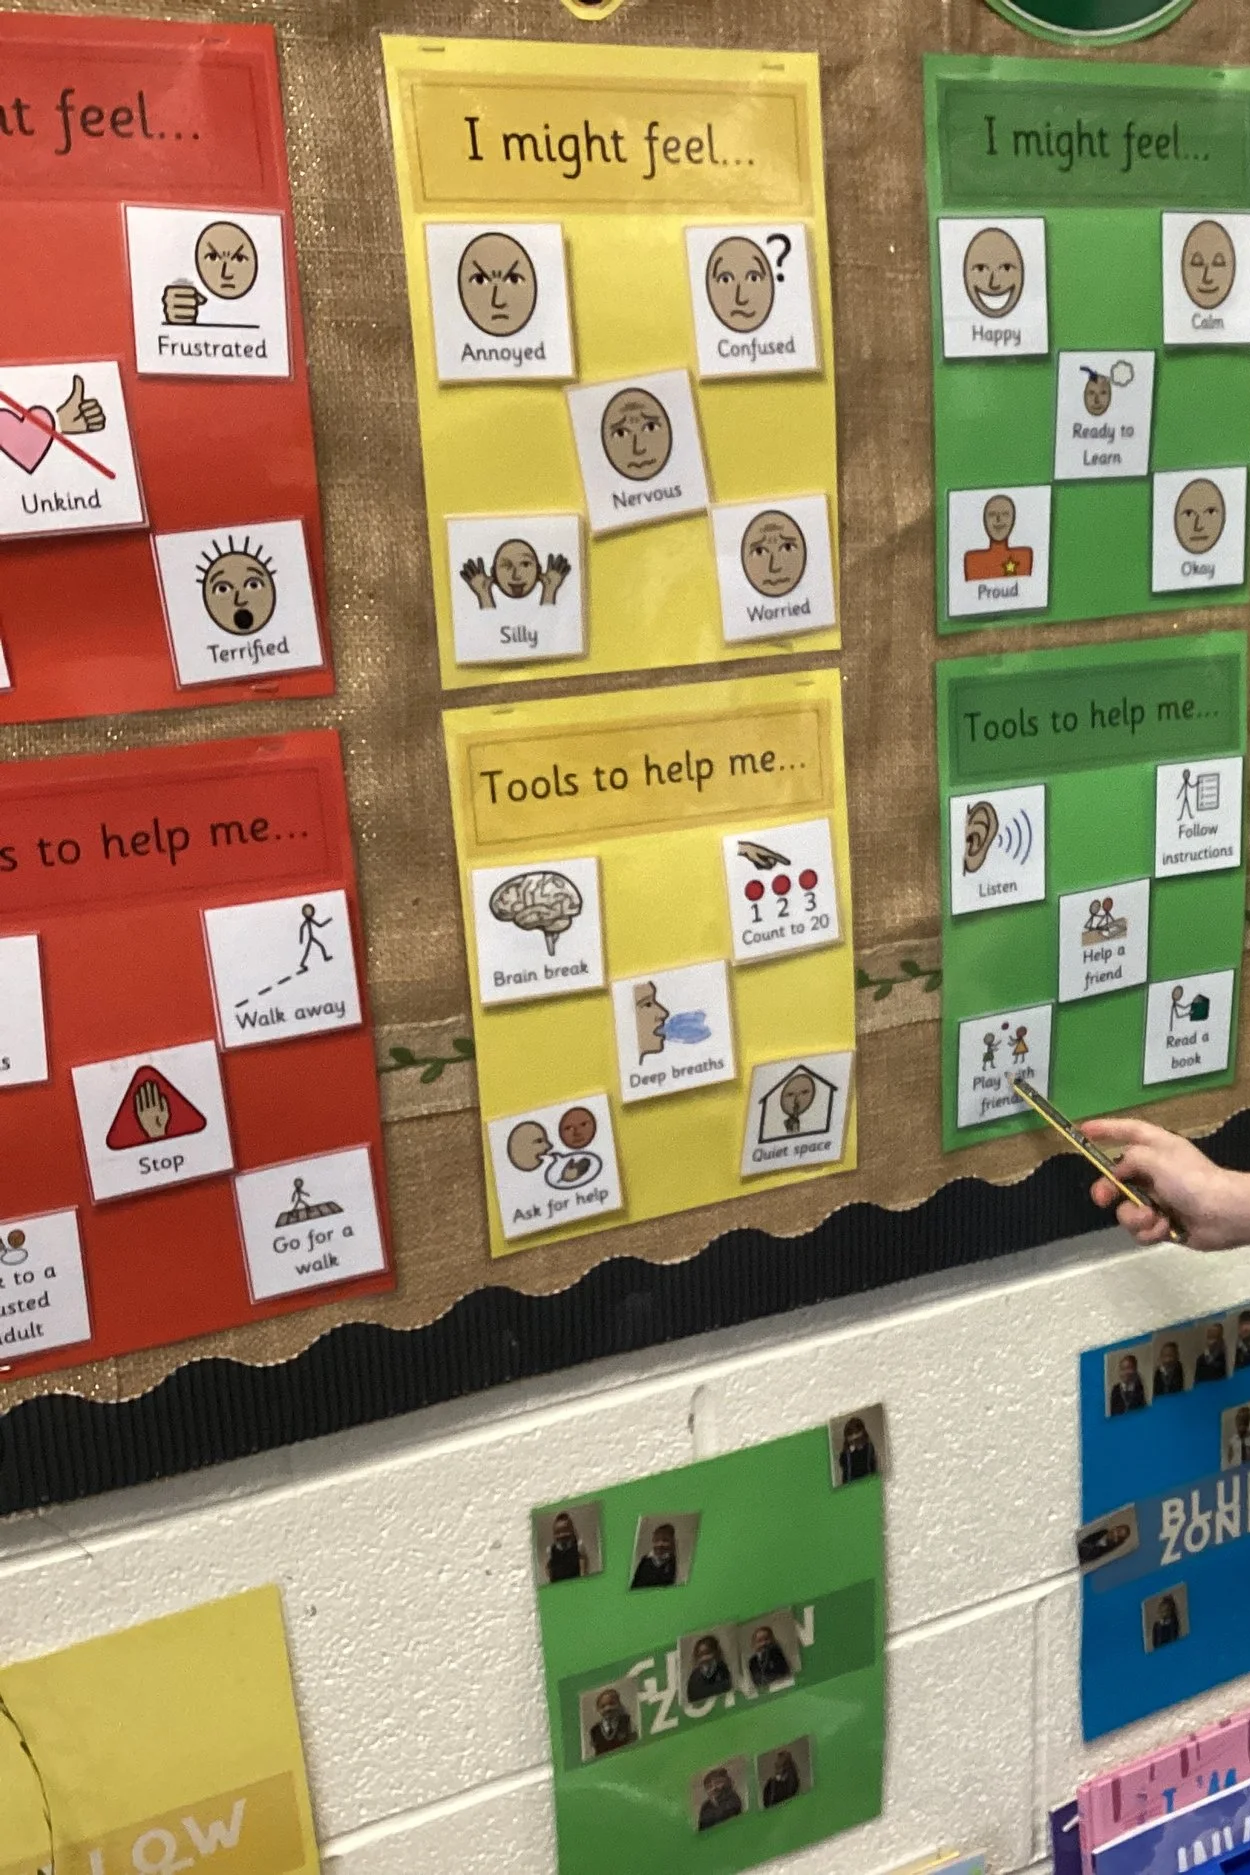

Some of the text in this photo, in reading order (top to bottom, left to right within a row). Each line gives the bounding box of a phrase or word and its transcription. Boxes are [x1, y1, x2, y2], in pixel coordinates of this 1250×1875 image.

[0, 88, 201, 155] t feel...
[464, 116, 755, 180] I might feel...
[984, 115, 1210, 173] I might feel...
[1191, 313, 1224, 330] Calm
[157, 335, 268, 359] Frustrated
[972, 325, 1021, 346] Happy
[461, 341, 546, 367] Annoyed
[717, 337, 796, 362] Confused
[1072, 422, 1135, 443] Ready to
[1083, 451, 1121, 466] Learn
[21, 488, 102, 514] Unkind
[612, 483, 682, 510] Nervous
[1181, 561, 1215, 579] Okay
[977, 583, 1019, 600] Proud
[746, 600, 811, 622] Worried
[500, 625, 538, 648] Silly
[207, 636, 290, 665] Terrified
[964, 697, 1219, 742] Tools to help me...
[480, 749, 806, 804] Tools to help me...
[37, 838, 81, 867] to
[100, 816, 190, 865] help
[210, 816, 309, 847] me...
[1178, 824, 1219, 839] Follow
[1162, 845, 1234, 865] instructions
[979, 880, 1018, 898] Listen
[750, 892, 817, 923] 1 2 3
[742, 913, 831, 946] Count to 20
[1083, 946, 1126, 965] Help a
[493, 962, 589, 987] Brain break
[1083, 965, 1123, 991] friend
[235, 999, 347, 1030] Walk away
[1166, 1033, 1210, 1049] Read a
[630, 1056, 725, 1089] Deep breaths
[1171, 1053, 1202, 1069] book
[972, 1075, 1002, 1092] Play
[981, 1094, 1026, 1116] friend
[139, 1153, 185, 1175] Stop
[752, 1140, 832, 1164] Quiet space
[512, 1187, 608, 1224] Ask for help
[273, 1225, 354, 1254] Go for a
[14, 1270, 35, 1286] to
[44, 1265, 57, 1279] a
[294, 1253, 340, 1276] walk
[0, 1321, 44, 1345] dult
